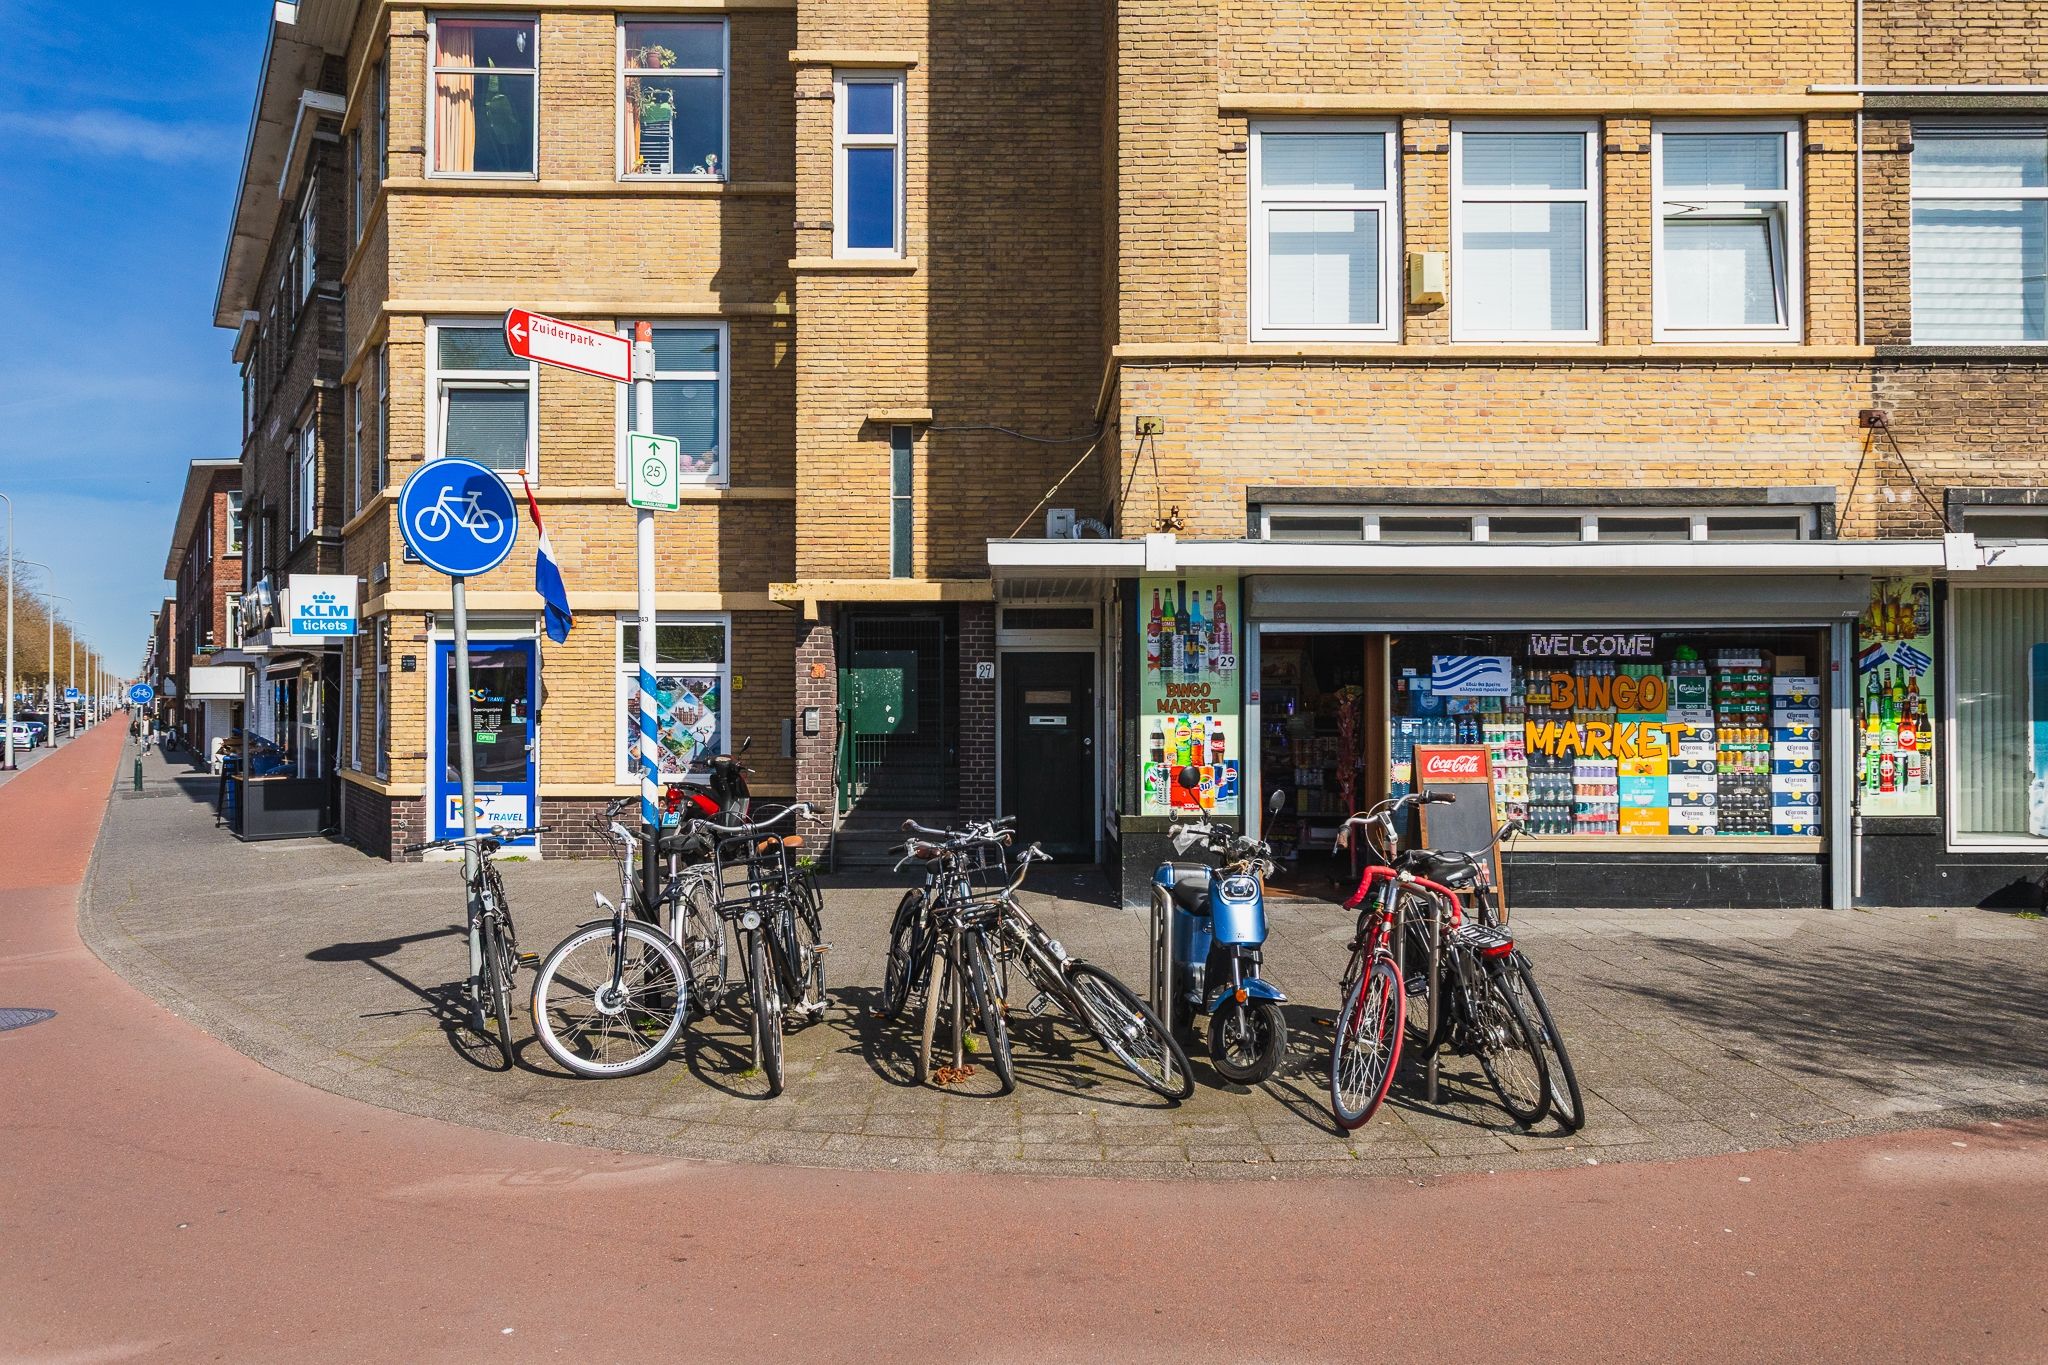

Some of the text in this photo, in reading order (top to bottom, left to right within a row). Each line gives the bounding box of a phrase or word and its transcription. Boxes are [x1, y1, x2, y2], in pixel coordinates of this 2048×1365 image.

[531, 319, 594, 347] Zuiderpark
[646, 465, 661, 478] 25
[300, 605, 349, 617] KLM
[303, 620, 348, 631] tickets
[1530, 634, 1653, 657] WELCOME
[1220, 656, 1235, 668] 29
[979, 664, 992, 679] 29
[1165, 682, 1211, 698] BINGO
[1549, 672, 1664, 710] BINGO
[1679, 684, 1705, 694] Carlsberg
[1157, 698, 1221, 715] MARKET
[1786, 712, 1809, 720] Corona
[1525, 719, 1688, 758] MARKET
[1680, 744, 1703, 752] Corona
[1426, 755, 1480, 773] Coca-Cola
[488, 813, 524, 821] TRAVEL
